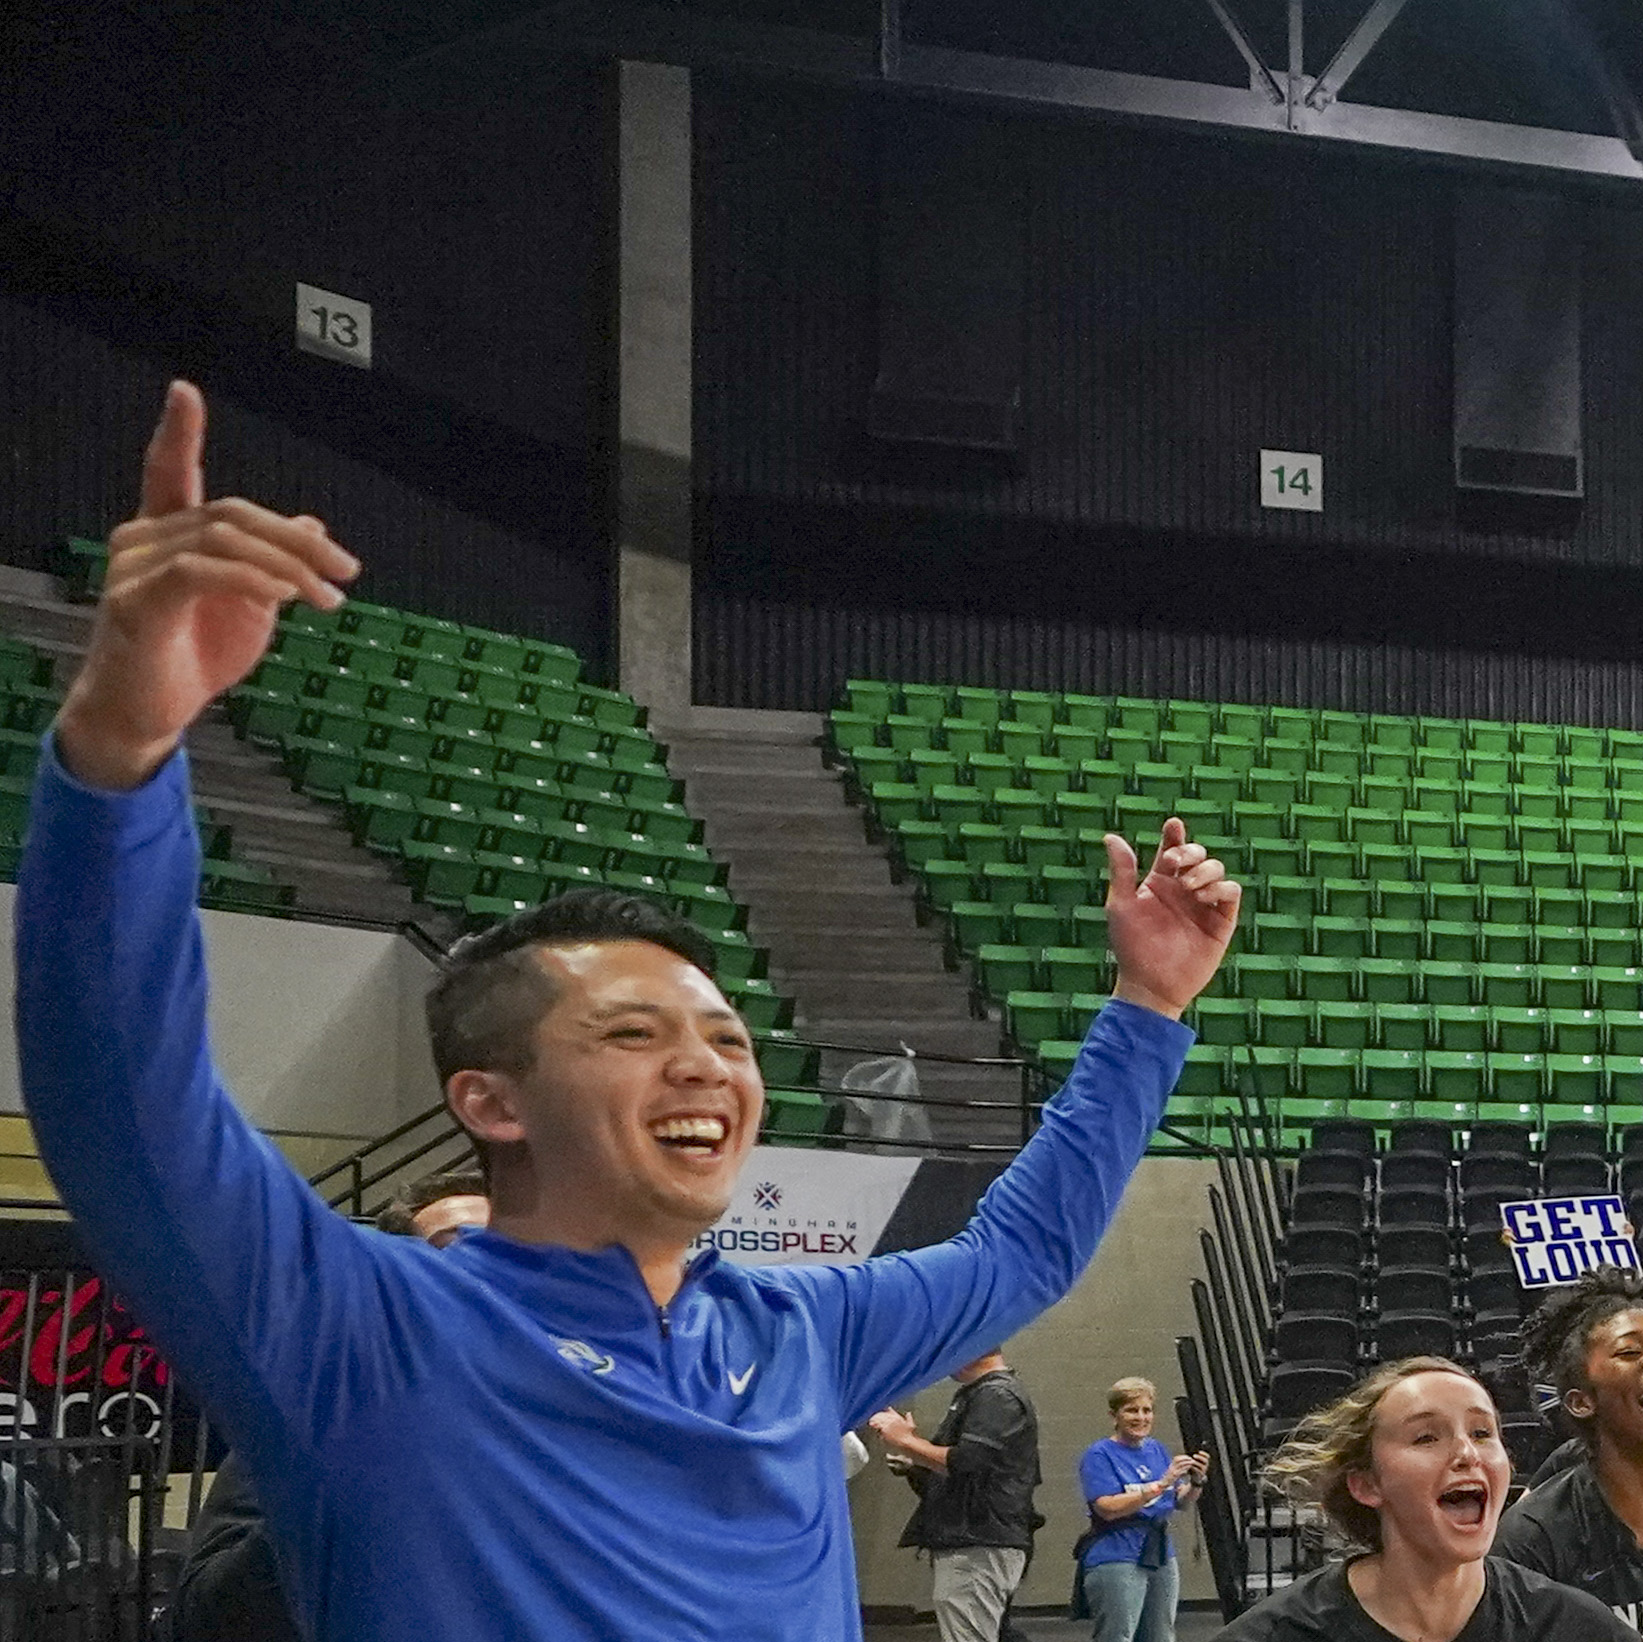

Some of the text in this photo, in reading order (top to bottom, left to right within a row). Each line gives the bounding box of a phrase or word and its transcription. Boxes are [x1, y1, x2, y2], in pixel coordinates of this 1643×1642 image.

[311, 306, 359, 348] 13
[1269, 465, 1313, 496] 14
[731, 1216, 857, 1231] MINGHAM
[1504, 1198, 1623, 1244] GET
[689, 1229, 858, 1255] ROSSPLEX
[0, 1392, 162, 1442] ero
